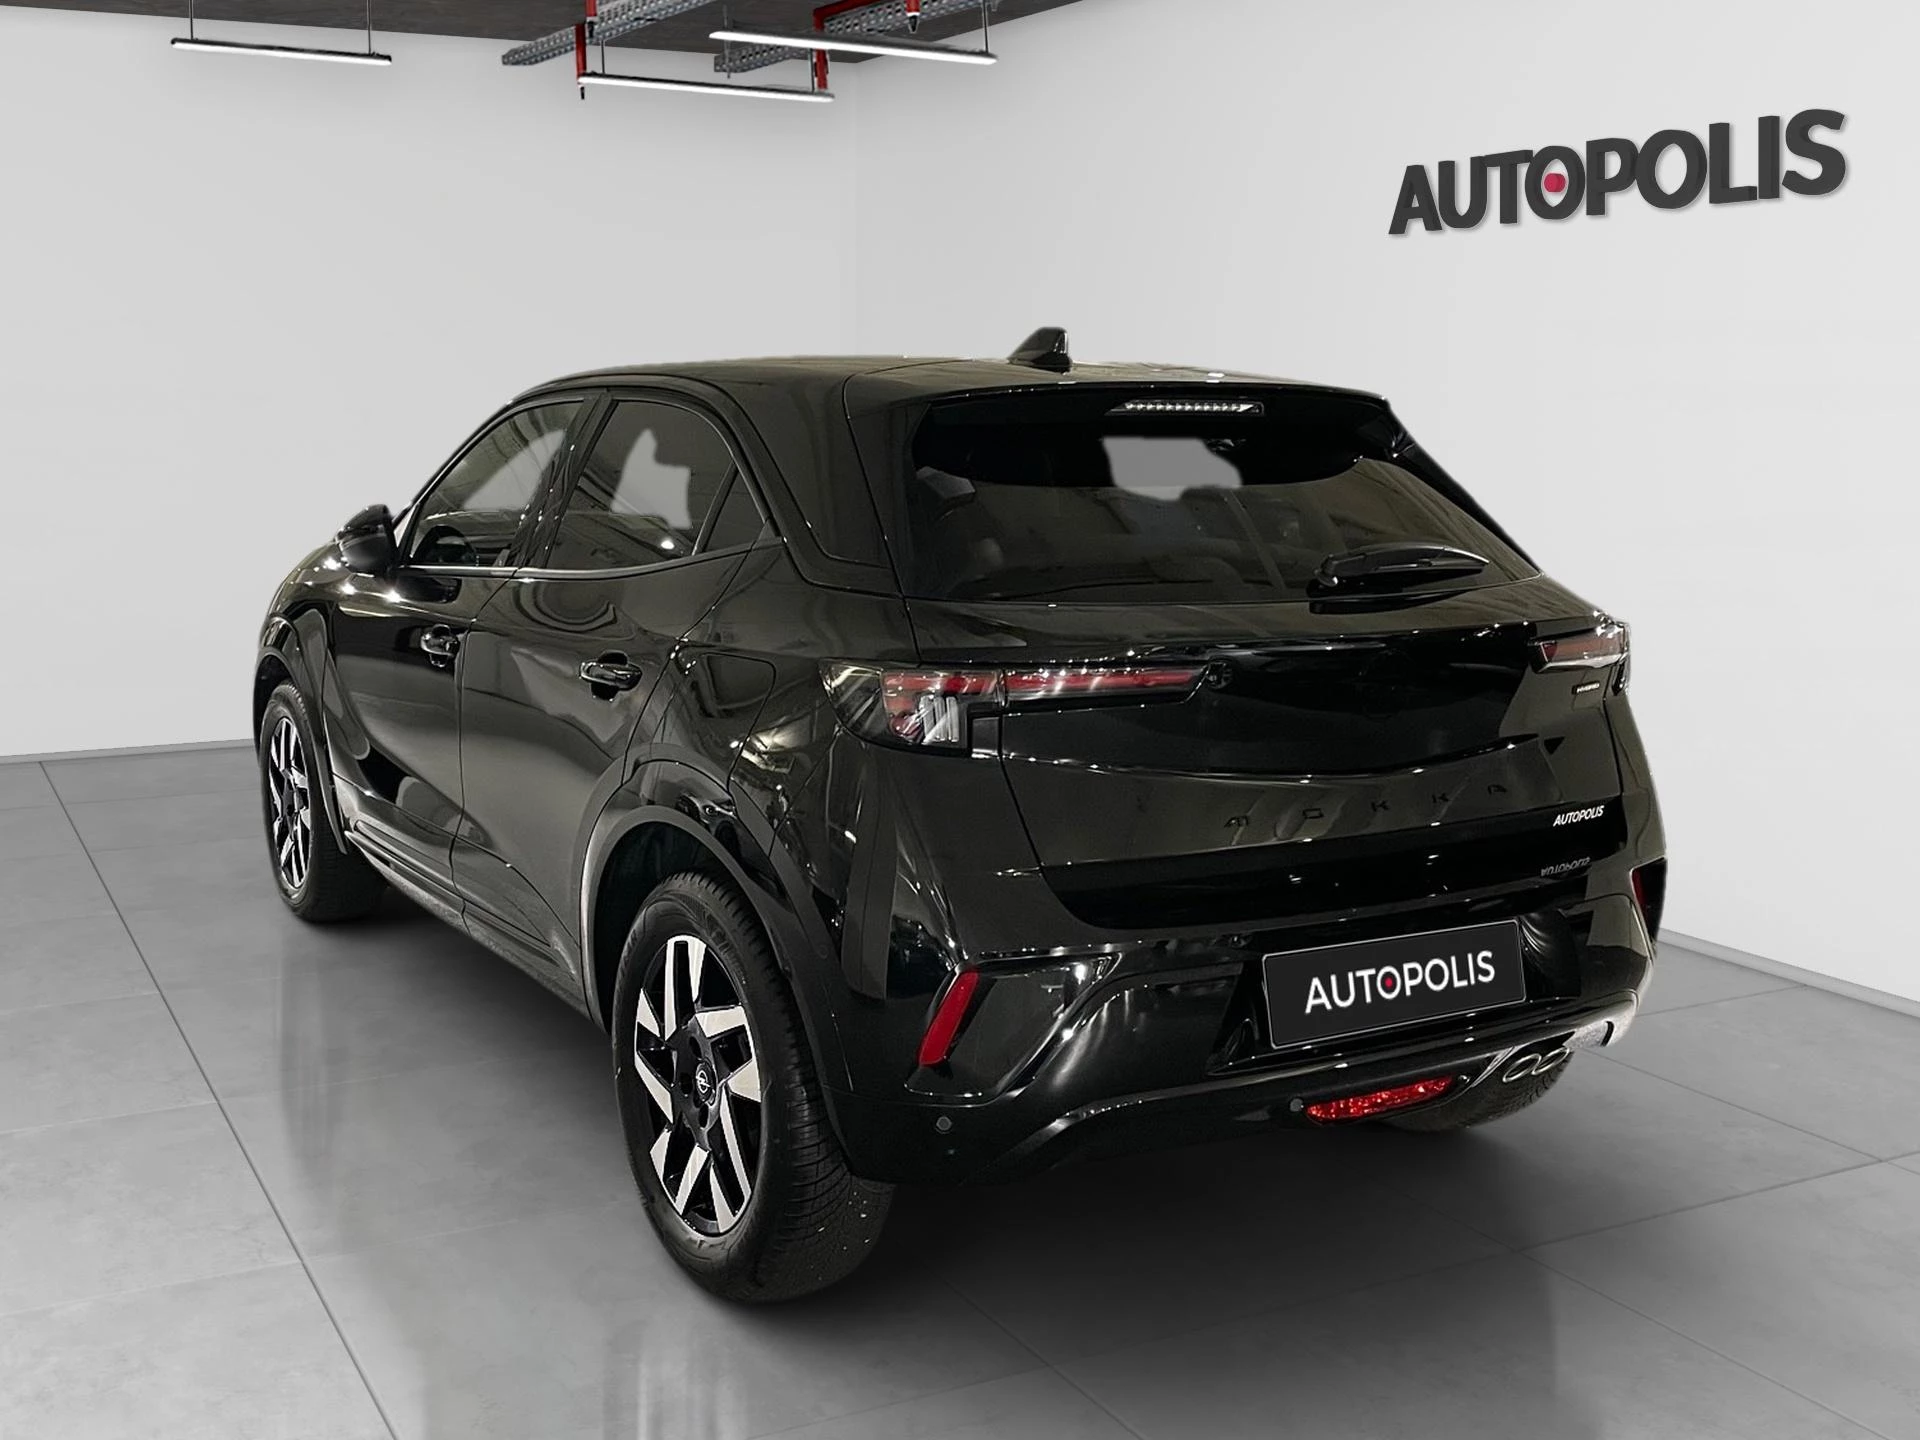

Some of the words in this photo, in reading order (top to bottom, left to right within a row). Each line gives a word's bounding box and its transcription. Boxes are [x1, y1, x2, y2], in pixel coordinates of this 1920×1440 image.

[1388, 108, 1846, 235] AUTOPOLIS
[1552, 805, 1606, 828] AUTOPOLIS
[1304, 950, 1496, 1014] AUTOPOLIS
